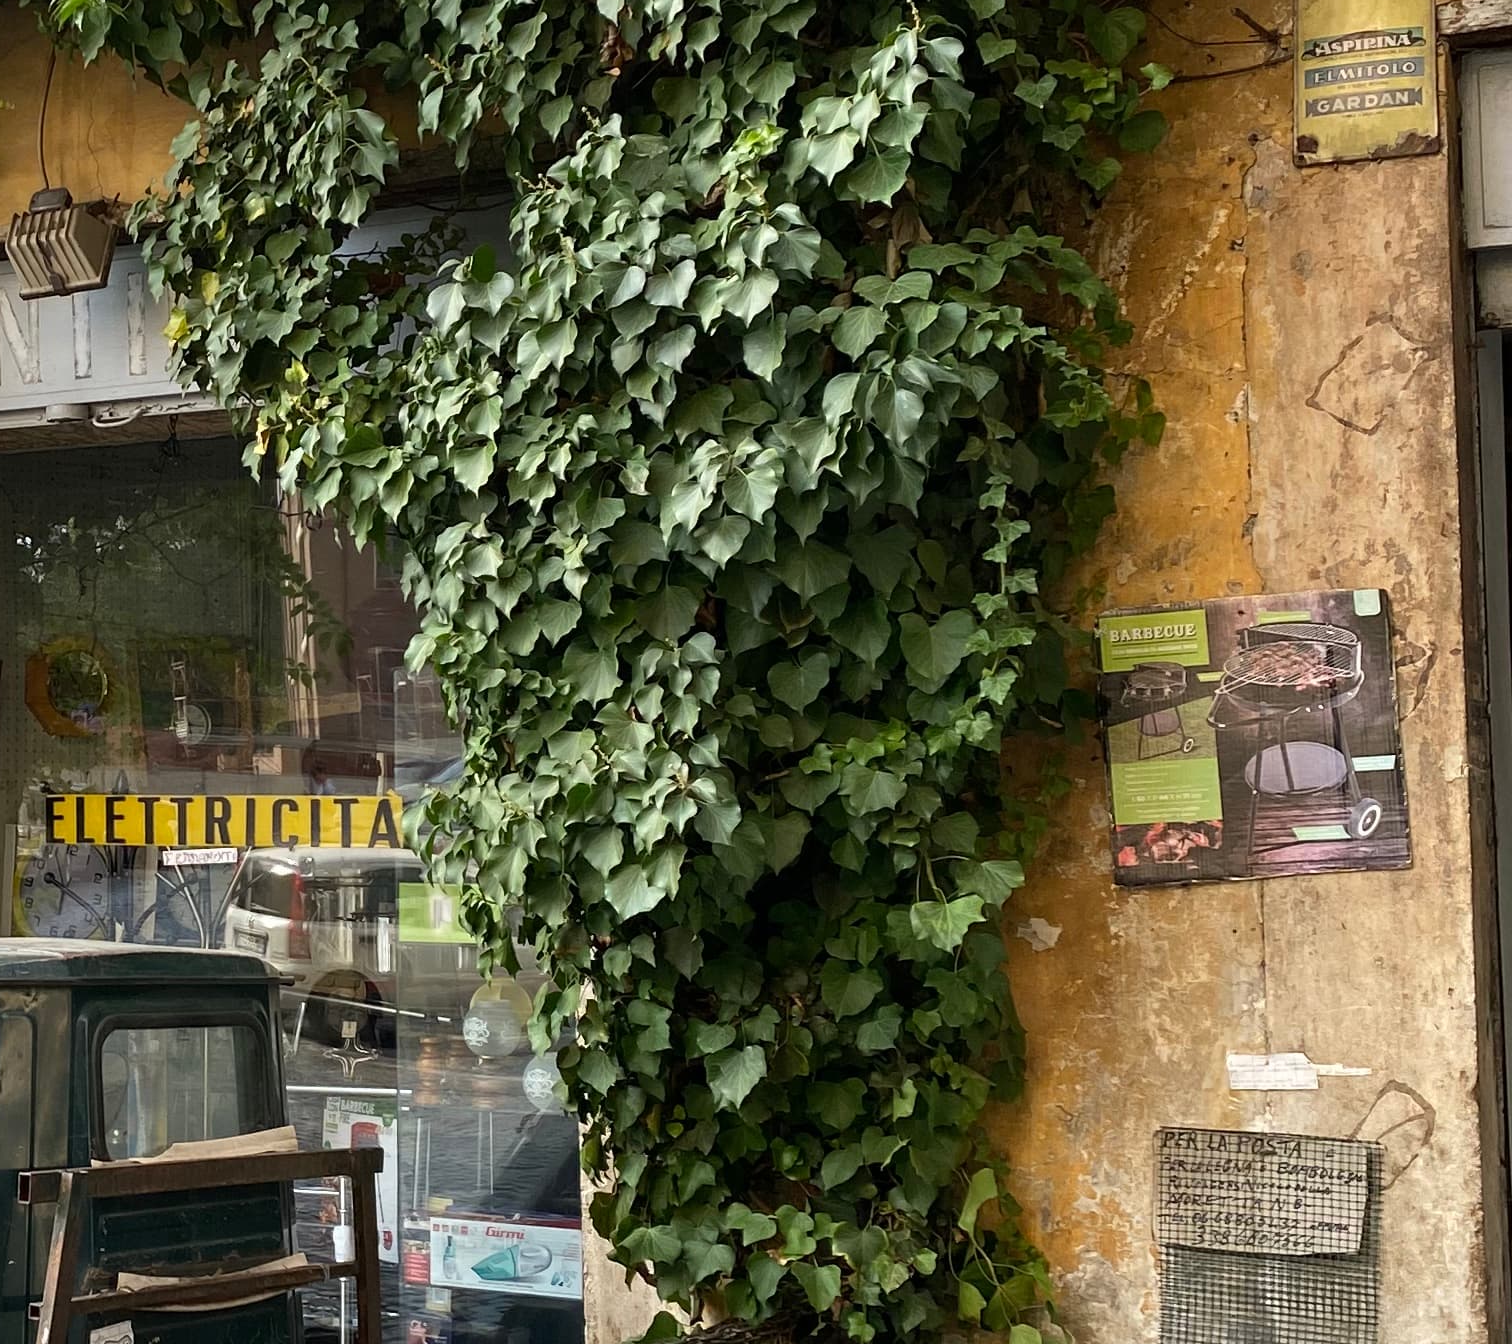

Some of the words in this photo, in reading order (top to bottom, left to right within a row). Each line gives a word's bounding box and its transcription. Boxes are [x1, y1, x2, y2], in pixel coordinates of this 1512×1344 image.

[1314, 34, 1412, 57] ASPIRINA
[1314, 61, 1416, 84] ELMITOLO
[1317, 90, 1409, 113] GARDAN
[1109, 623, 1197, 643] BARBECUE
[46, 796, 402, 849] ELETTRICITA
[340, 1098, 376, 1115] BARBECUE
[1163, 1131, 1199, 1151] PER
[1208, 1134, 1228, 1153] LA
[1238, 1136, 1303, 1158] POSTA
[485, 1226, 525, 1240] Girmi
